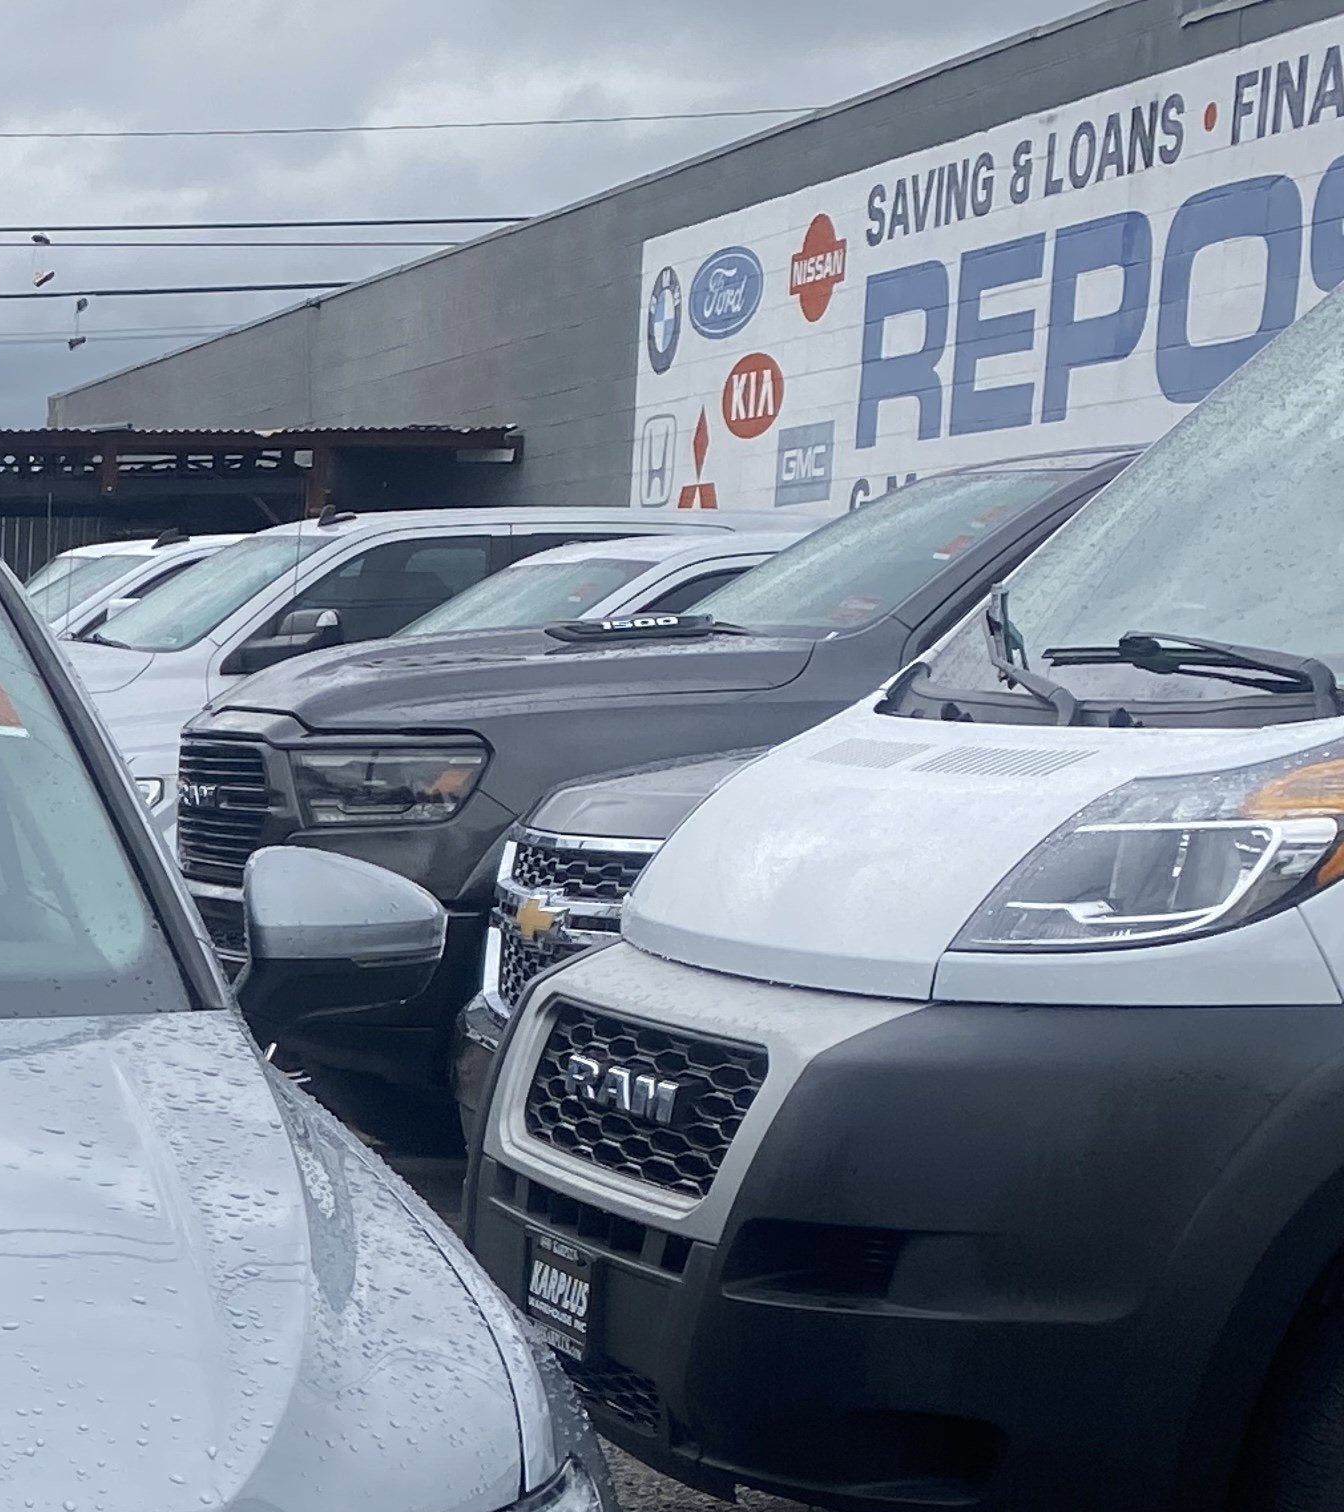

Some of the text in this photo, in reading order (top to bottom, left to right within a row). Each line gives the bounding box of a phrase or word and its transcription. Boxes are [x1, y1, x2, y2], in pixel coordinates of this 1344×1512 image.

[866, 44, 1344, 247] SAVING & LOANS FINA
[703, 266, 748, 319] Ford
[792, 247, 845, 289] NISSAN
[731, 368, 774, 421] KIA
[782, 444, 827, 481] GMC
[601, 616, 679, 631] 1500
[564, 1054, 680, 1124] RAM
[529, 1259, 590, 1318] KARPLUS
